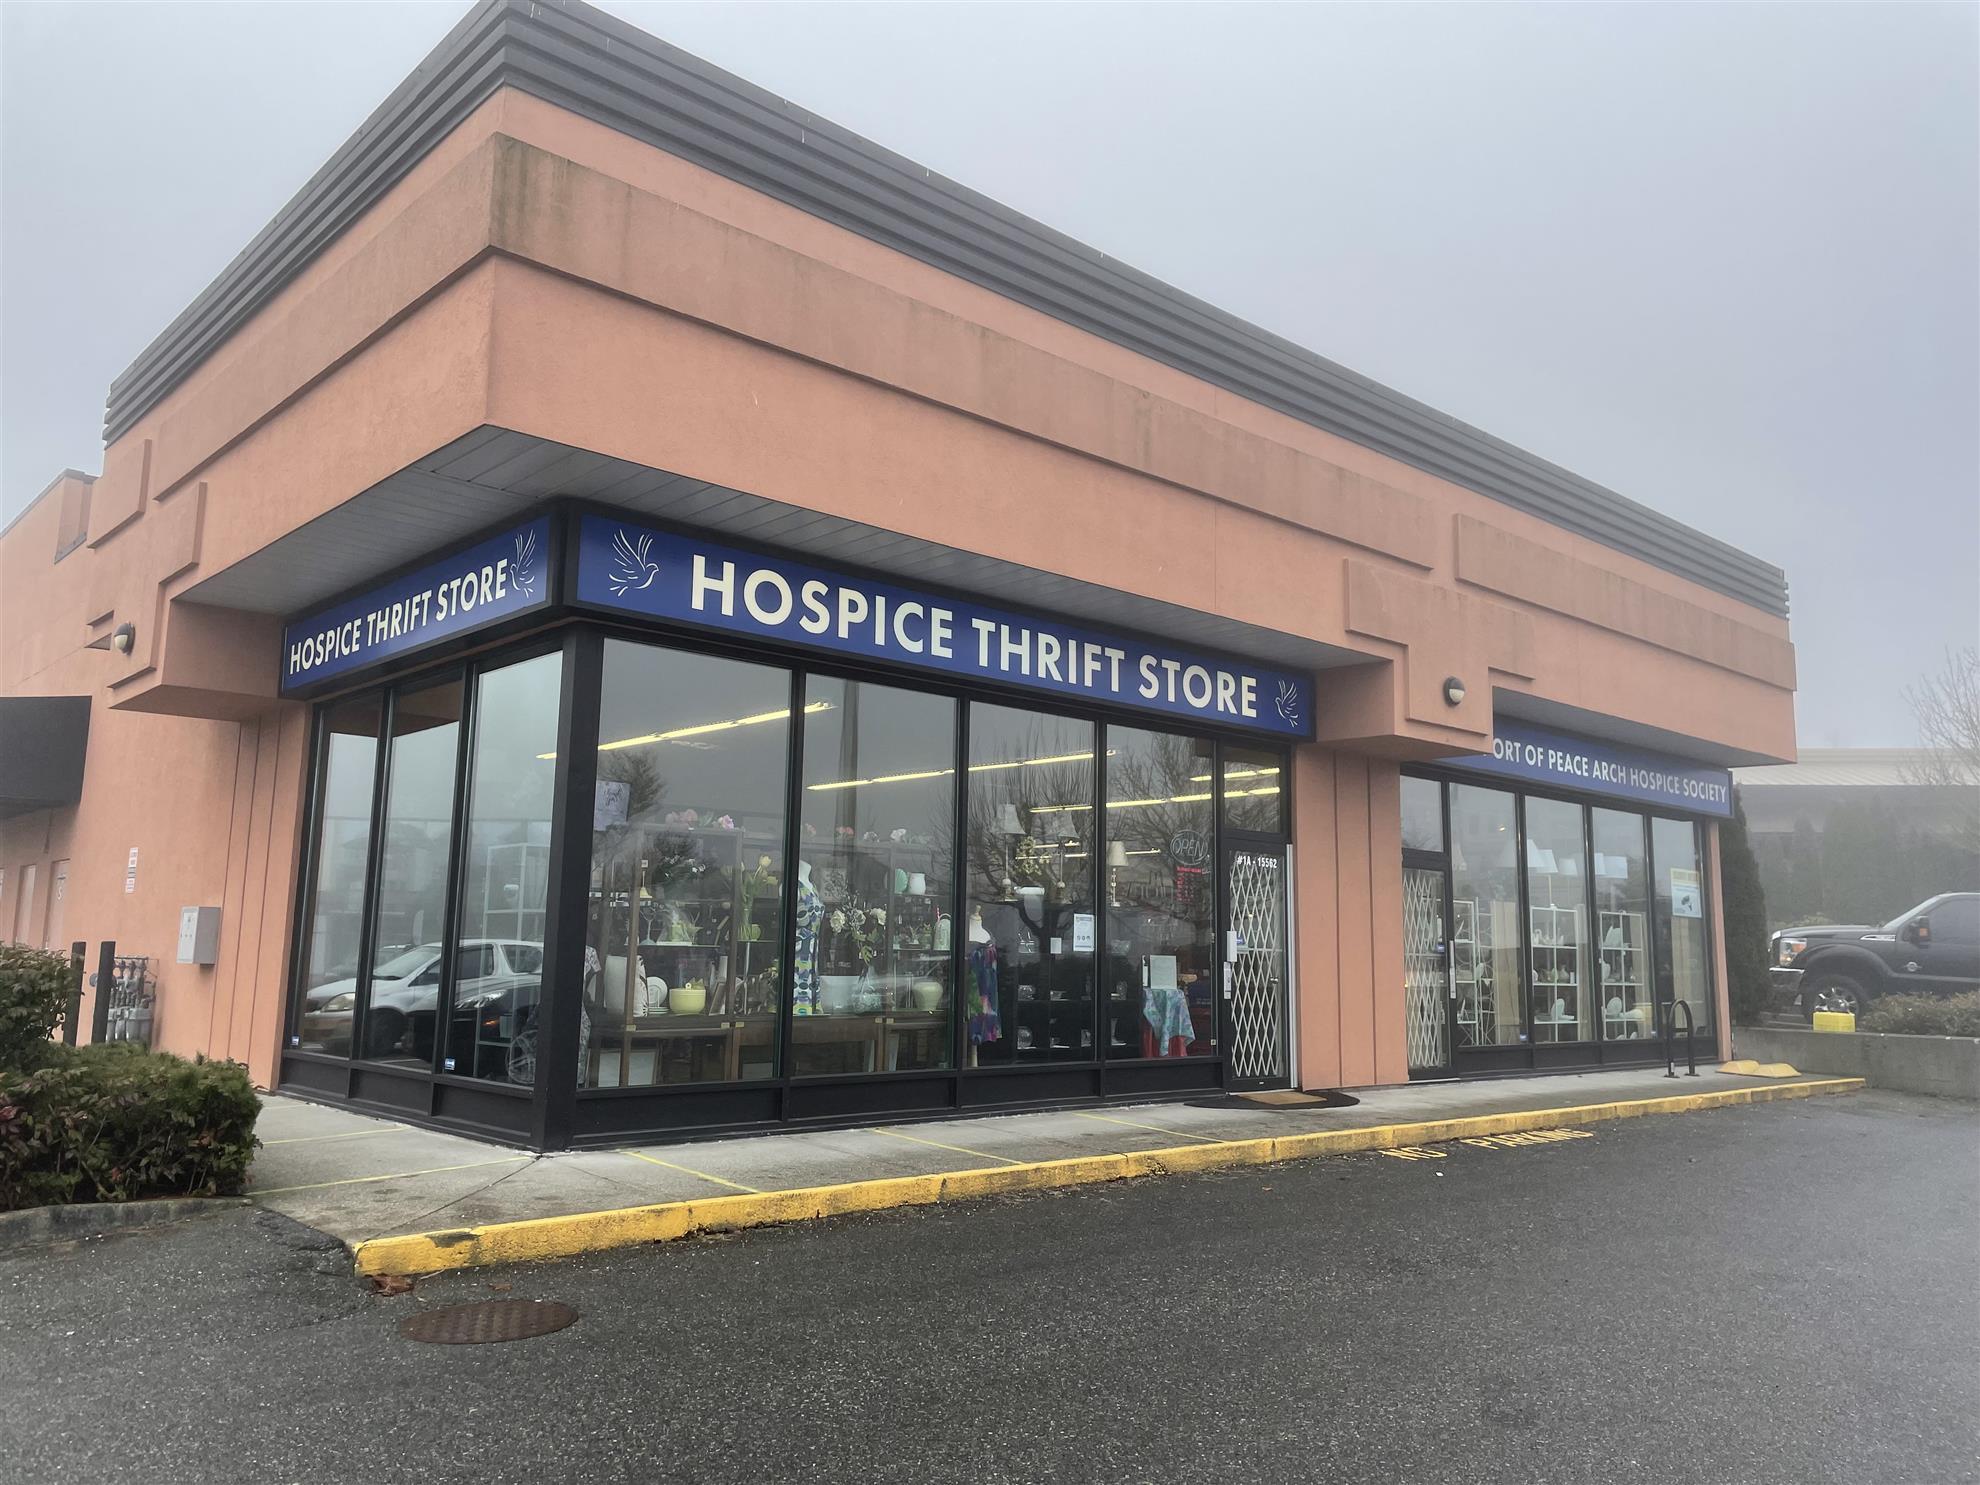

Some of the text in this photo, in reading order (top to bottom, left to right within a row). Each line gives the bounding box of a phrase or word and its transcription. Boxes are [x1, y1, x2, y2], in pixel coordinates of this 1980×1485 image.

[290, 559, 508, 674] HOSPICE THRIFT STORE
[691, 555, 1257, 718] HOSPICE THRIFT STORE
[1525, 744, 1544, 767] OF
[1548, 749, 1589, 777] PEACE
[1592, 760, 1627, 785] ARCH
[1630, 768, 1681, 795] HOSPICE
[1682, 778, 1727, 804] SOCIETY
[1173, 838, 1205, 857] OPEN
[1237, 855, 1251, 866] #1A
[1378, 1127, 1594, 1161] NO PARKING
